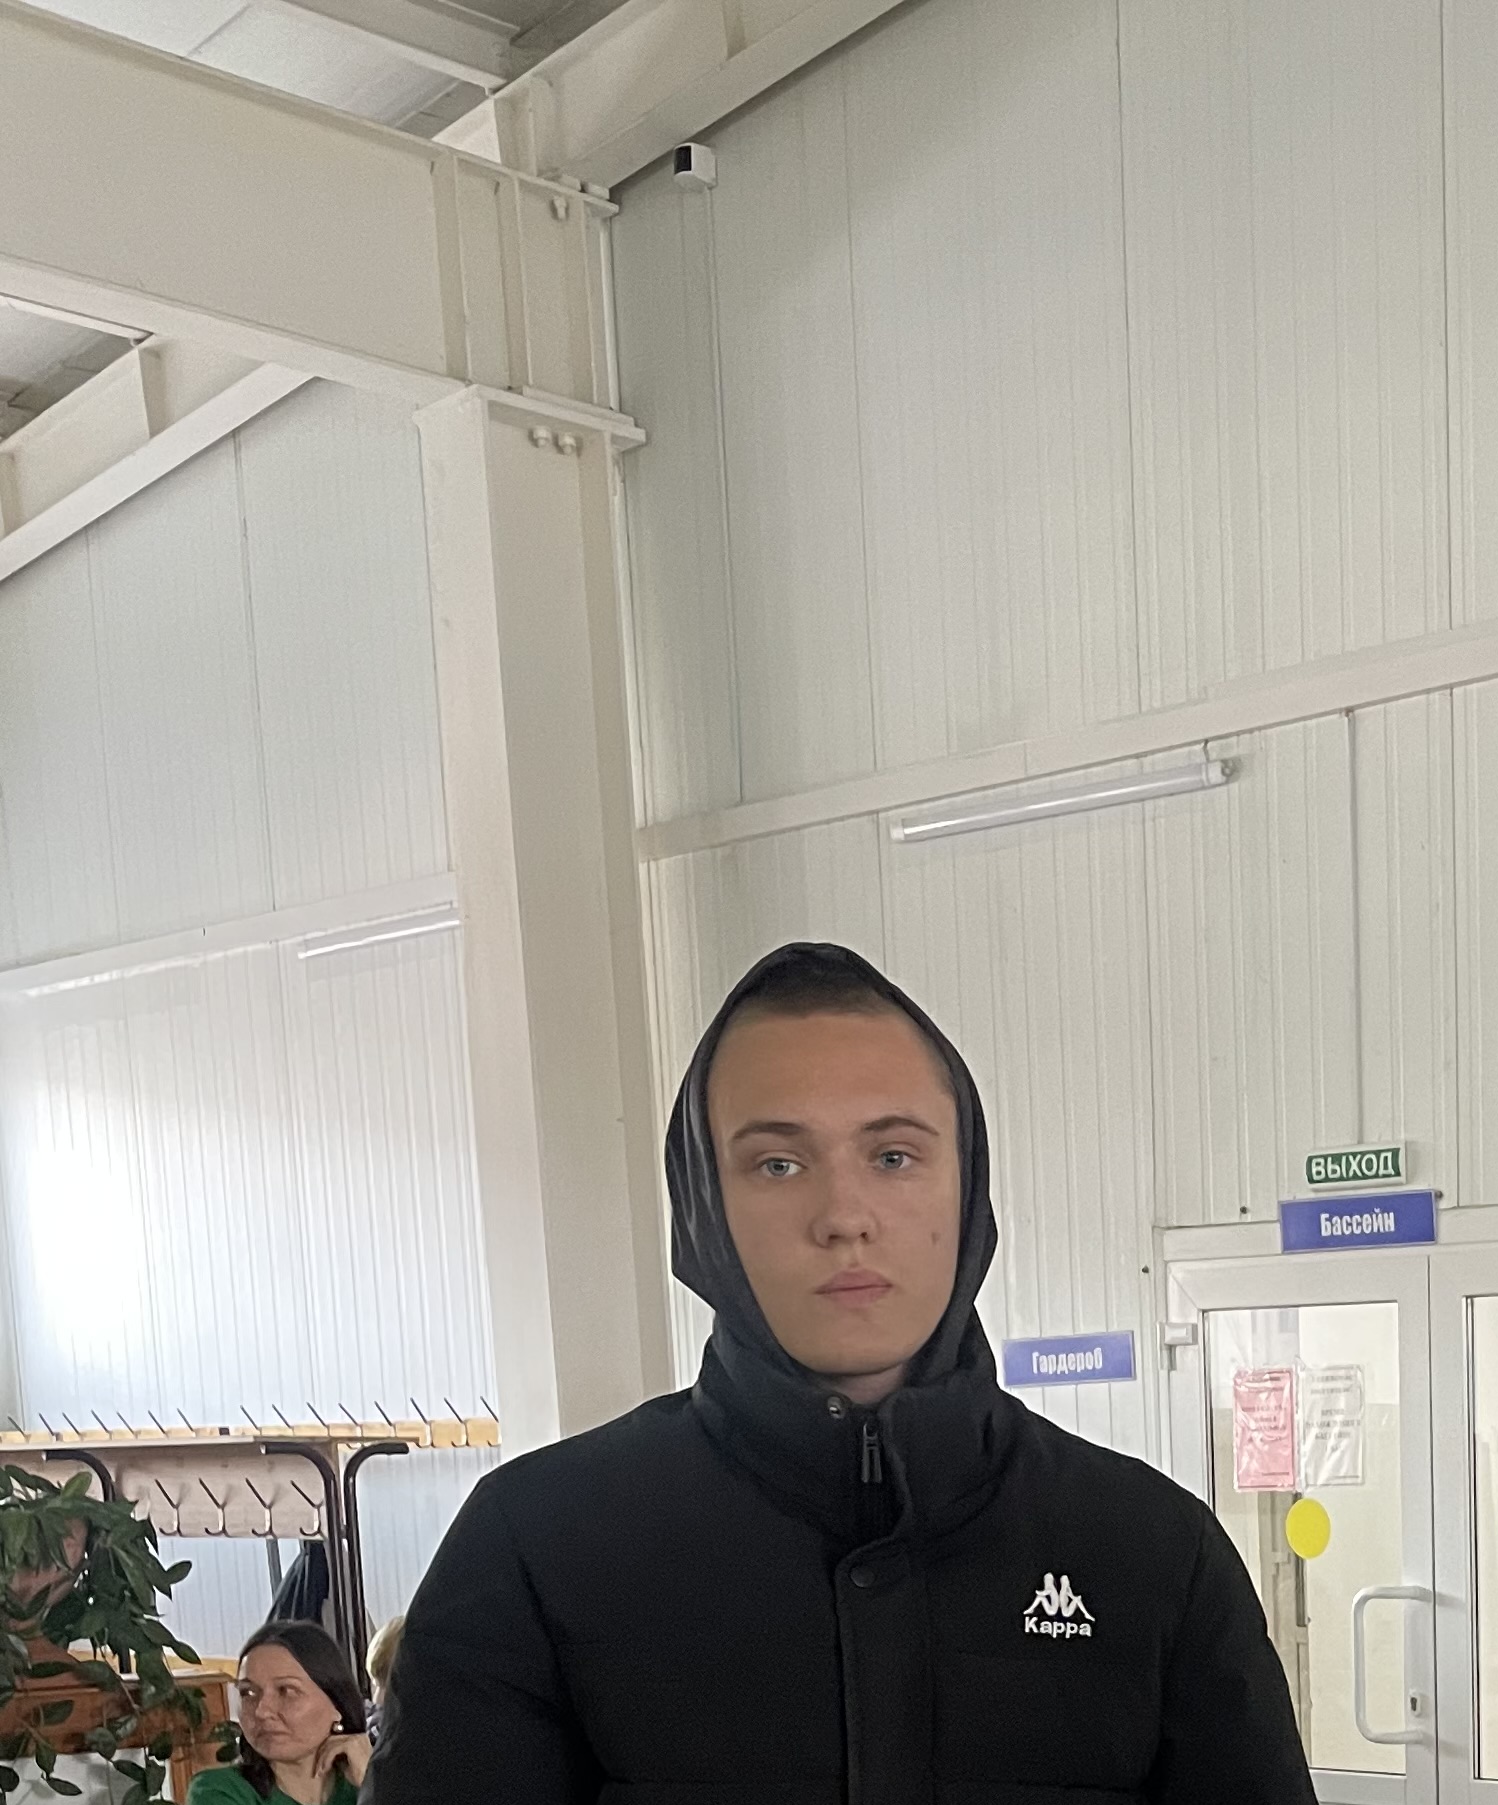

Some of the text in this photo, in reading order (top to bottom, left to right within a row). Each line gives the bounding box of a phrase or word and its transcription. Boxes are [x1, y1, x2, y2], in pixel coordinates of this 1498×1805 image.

[1311, 1152, 1395, 1181] ВЫХОД
[1320, 1207, 1395, 1237] Бассейн
[1032, 1347, 1103, 1375] Гардероб
[1024, 1616, 1092, 1638] Kappa
